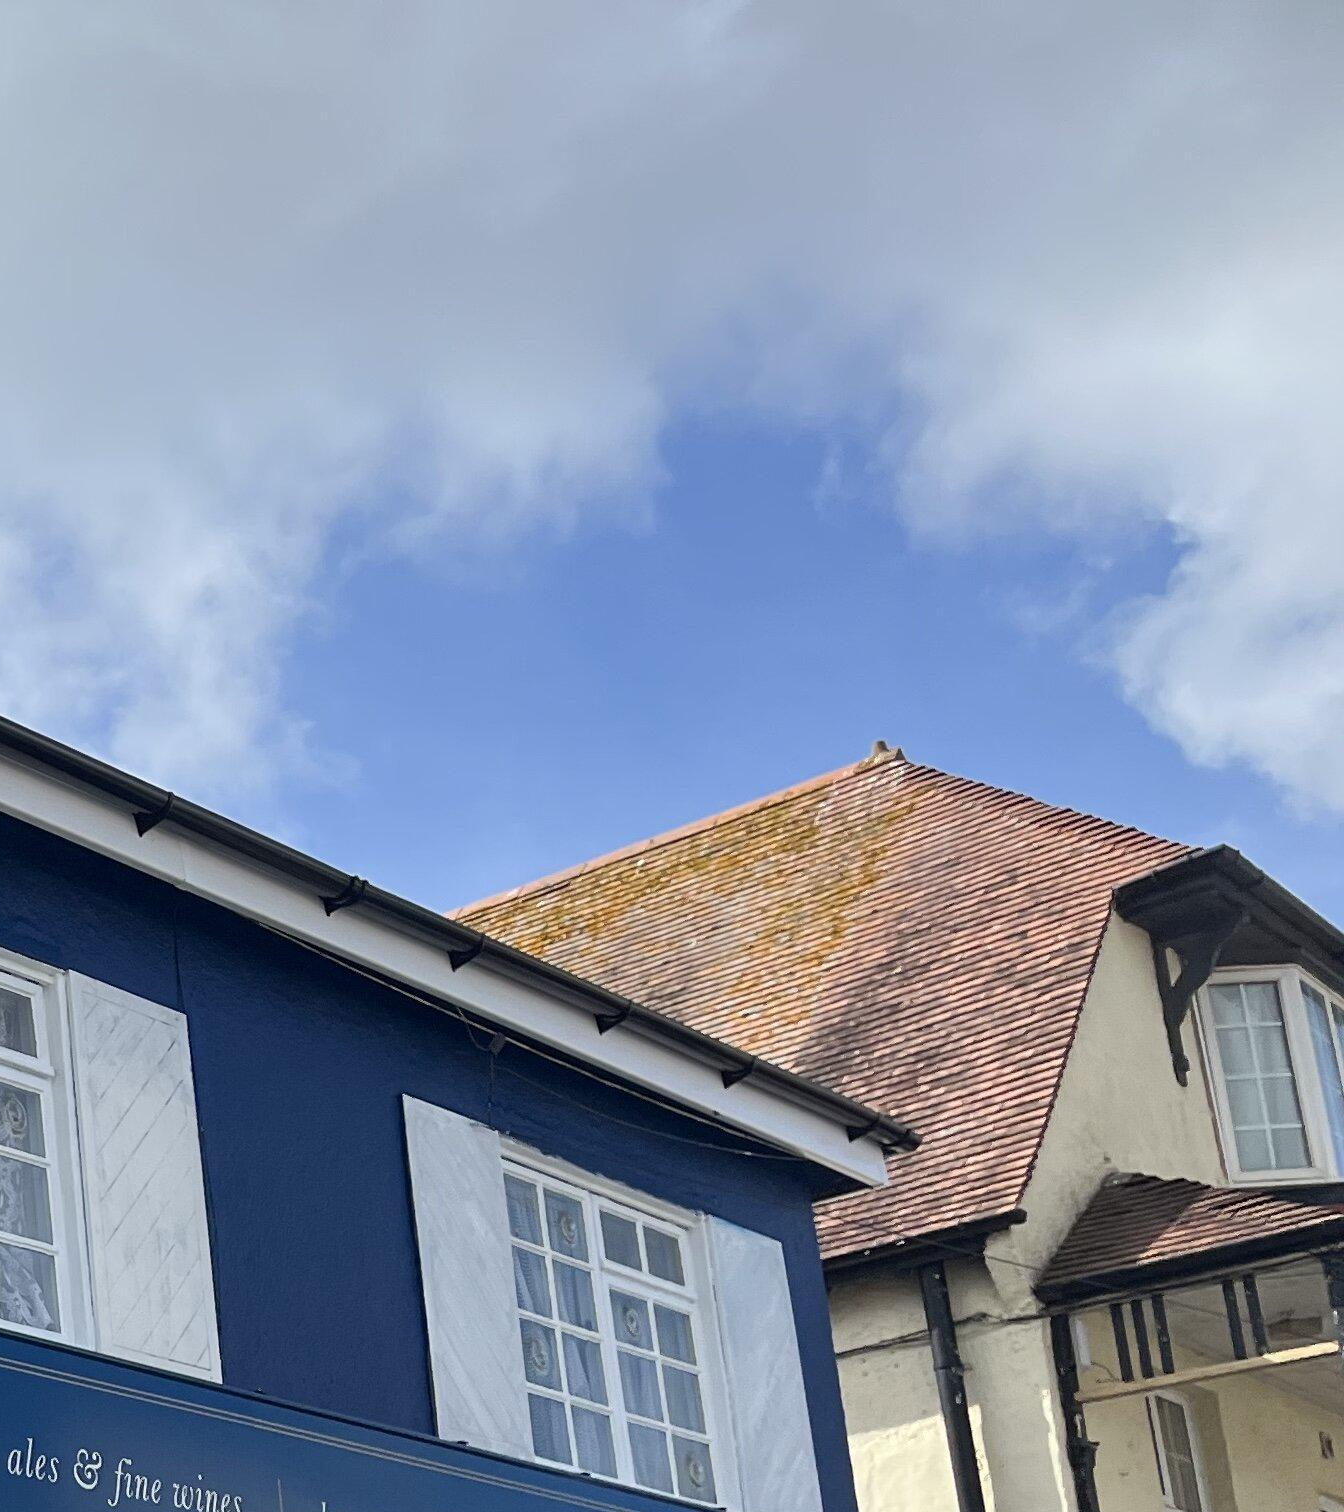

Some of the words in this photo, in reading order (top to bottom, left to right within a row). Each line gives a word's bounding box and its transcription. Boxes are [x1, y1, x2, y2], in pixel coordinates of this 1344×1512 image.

[8, 1438, 59, 1483] ales
[74, 1449, 102, 1489] &
[108, 1458, 161, 1506] fine
